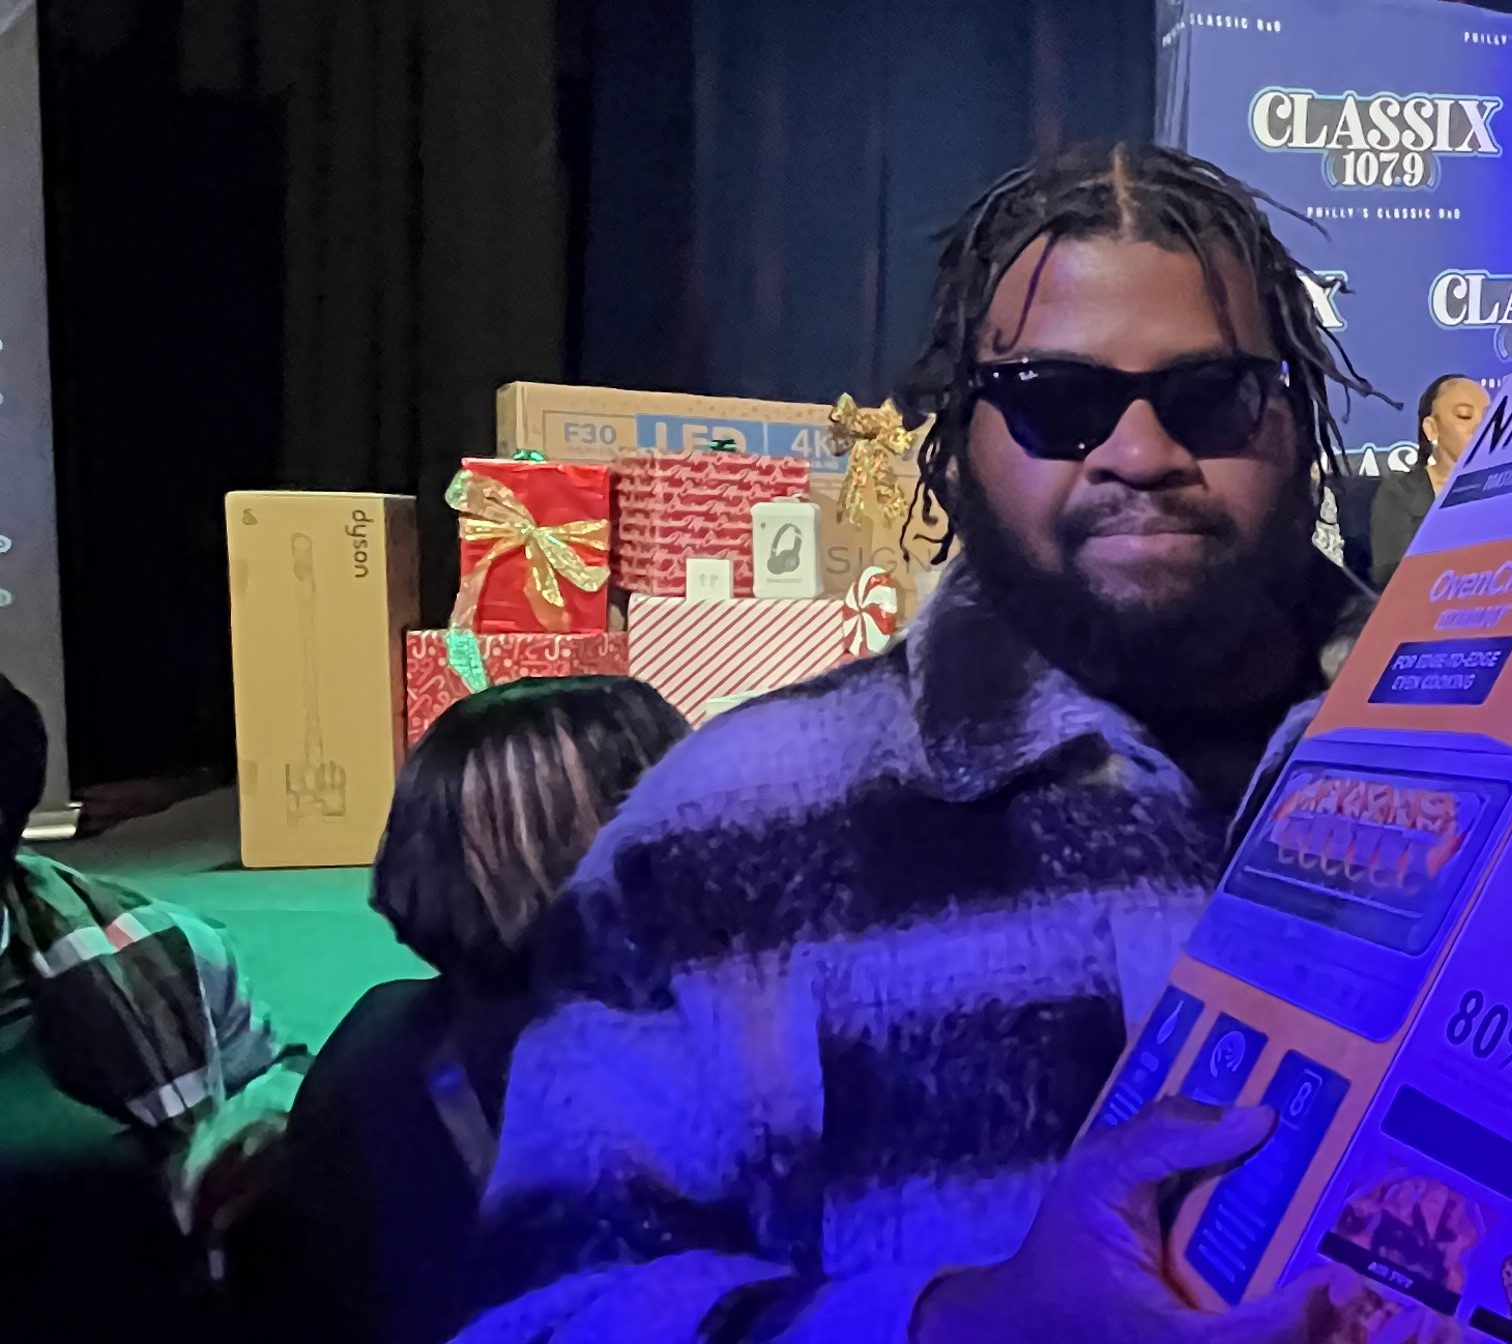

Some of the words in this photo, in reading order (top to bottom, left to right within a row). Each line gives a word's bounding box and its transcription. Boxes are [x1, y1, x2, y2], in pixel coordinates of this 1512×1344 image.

[1251, 91, 1499, 154] CLASSIX
[1342, 152, 1426, 187] 107.9
[564, 422, 617, 445] F30
[345, 509, 375, 578] dyson
